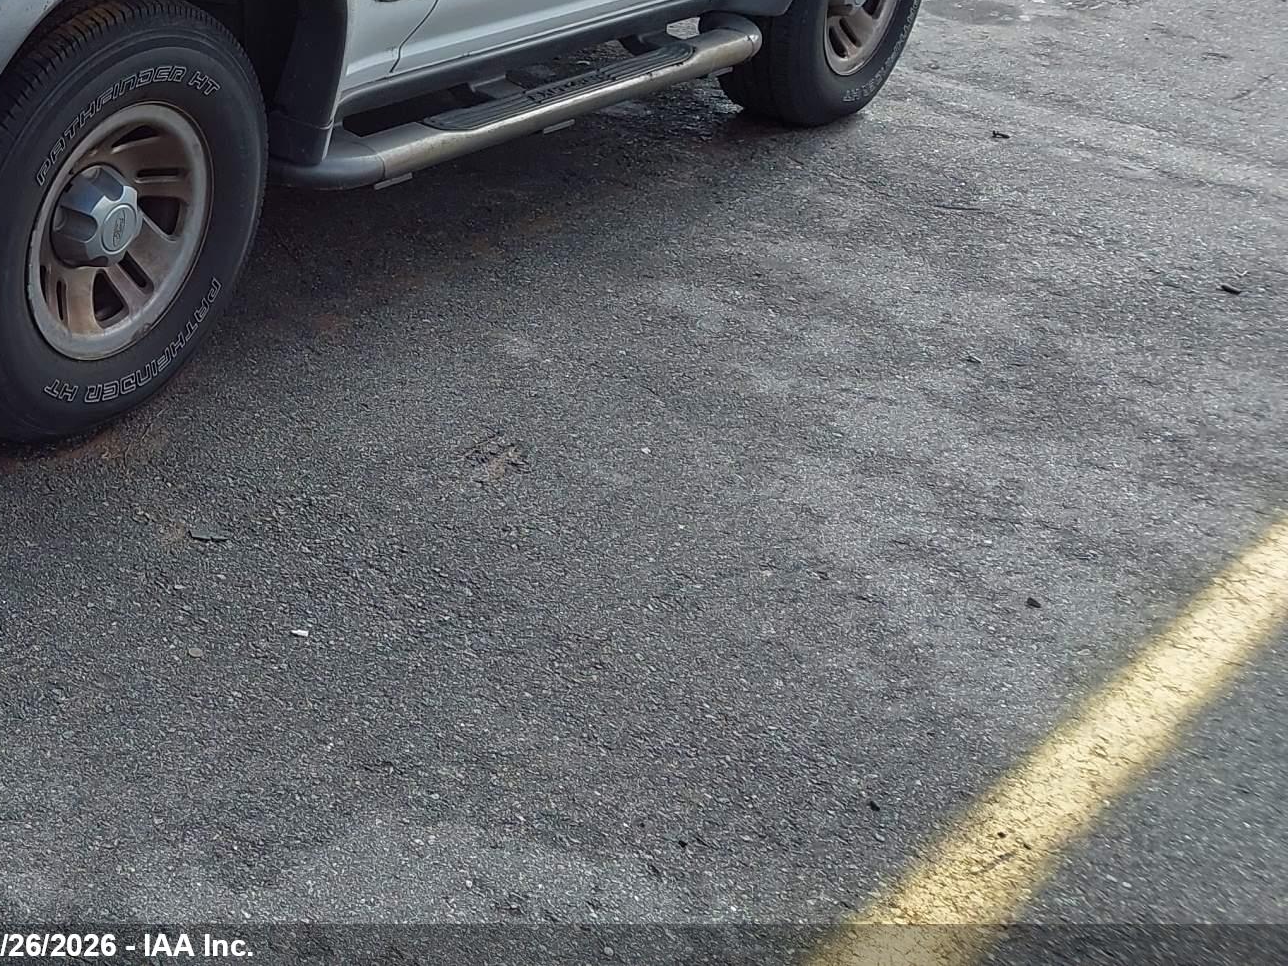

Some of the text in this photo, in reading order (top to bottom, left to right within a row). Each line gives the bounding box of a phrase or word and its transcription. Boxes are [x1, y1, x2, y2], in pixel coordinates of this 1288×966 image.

[36, 66, 221, 187] PATHFINDER HT
[44, 278, 222, 403] PATHFINDER HT
